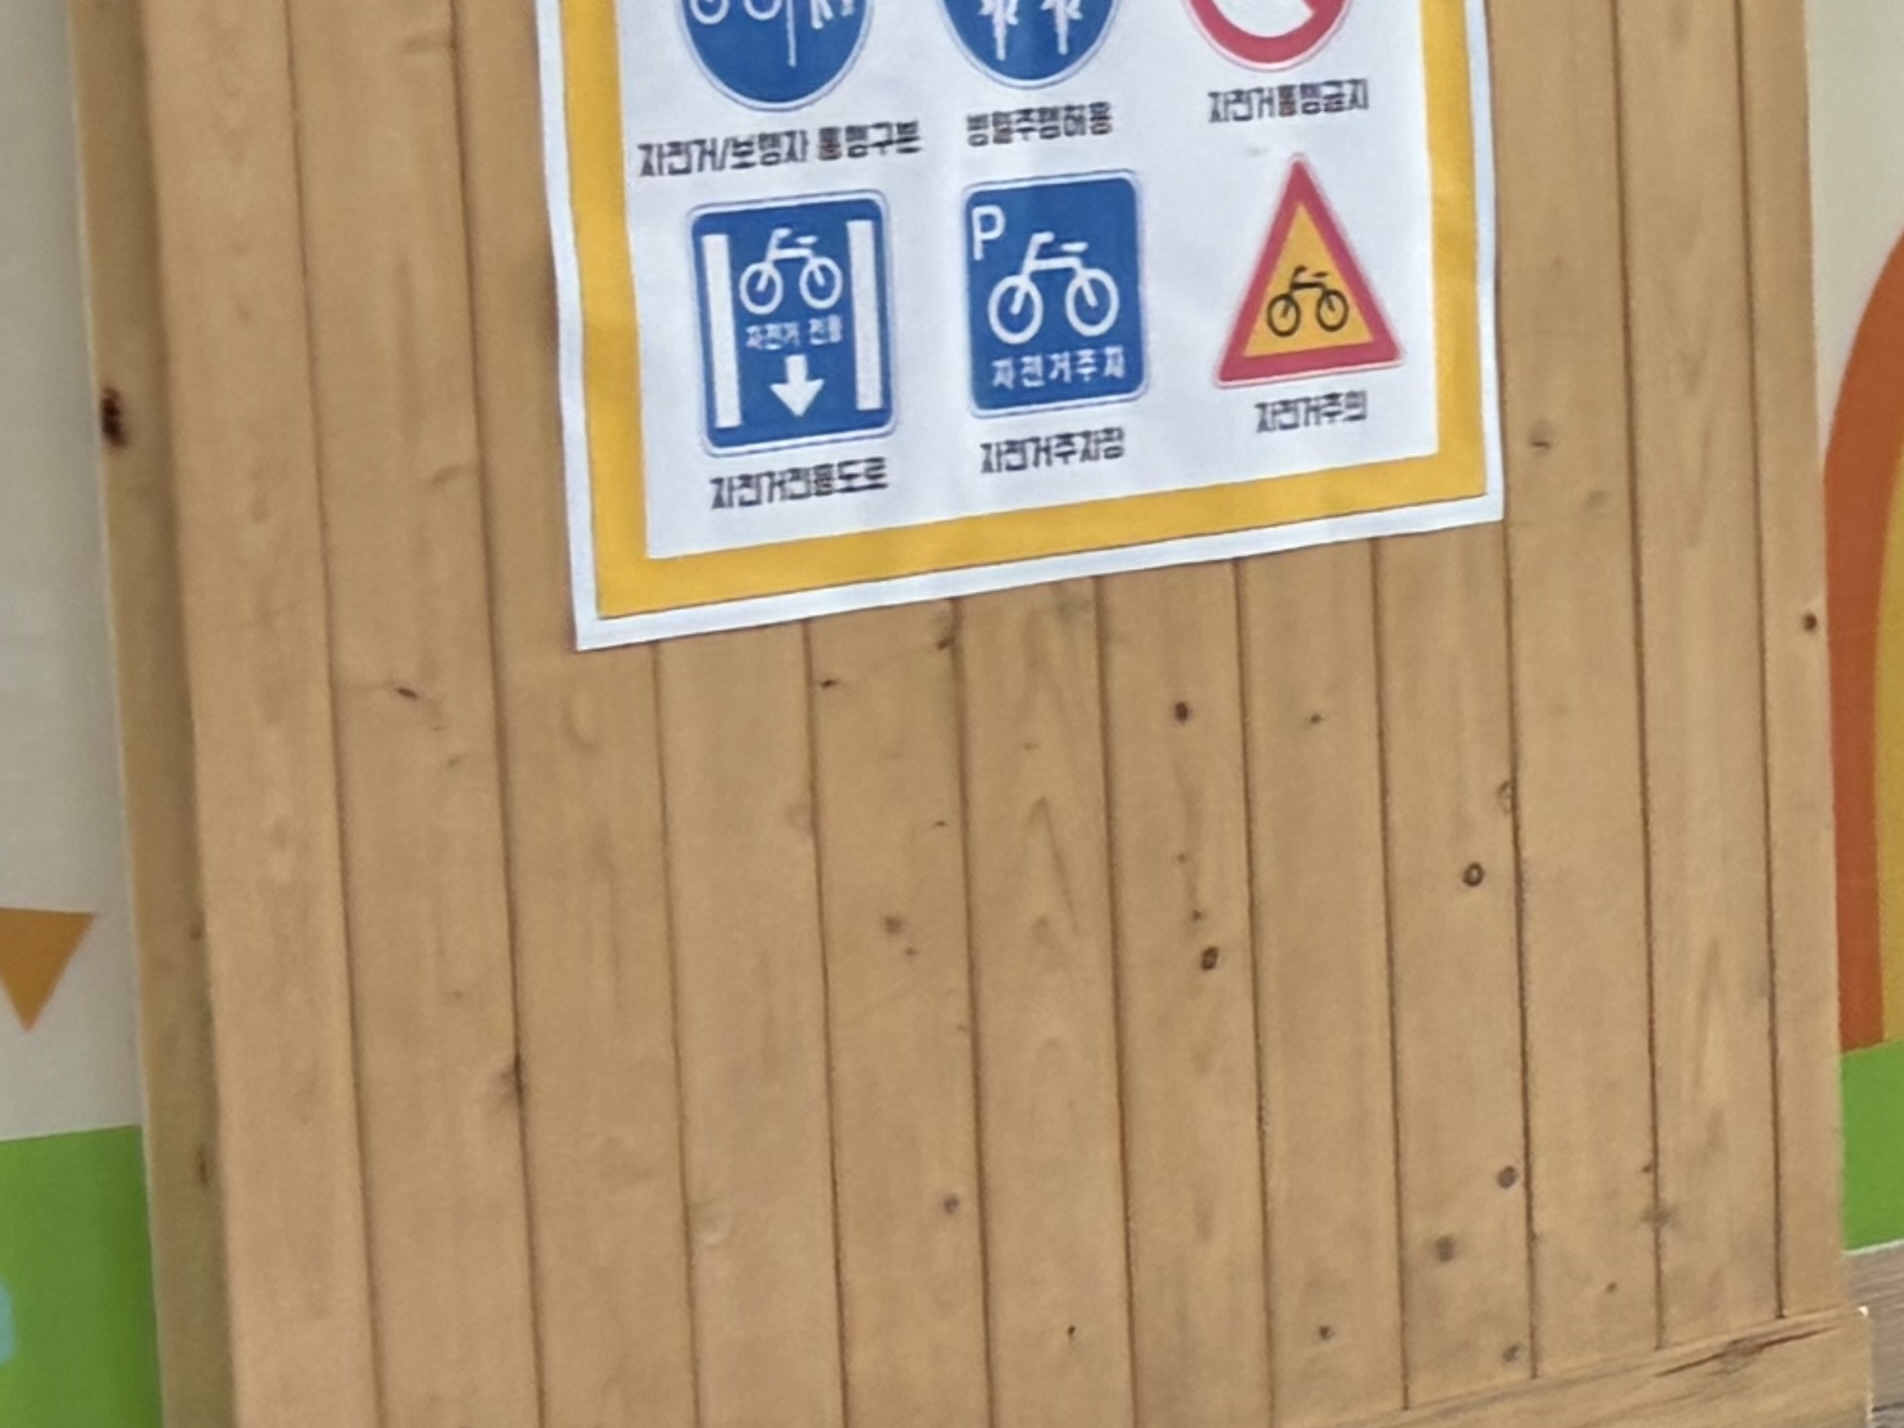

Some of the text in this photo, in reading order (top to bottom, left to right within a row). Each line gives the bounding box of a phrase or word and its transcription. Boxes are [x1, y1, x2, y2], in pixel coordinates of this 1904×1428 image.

[1207, 77, 1369, 124] 자전거통행금지
[636, 119, 923, 178] 자전거/보행자 통행구분
[971, 205, 1006, 261] P
[1254, 389, 1368, 434] 자전거주의
[979, 426, 1126, 474] 자전거주차장
[708, 456, 890, 511] 자전거전용도로
